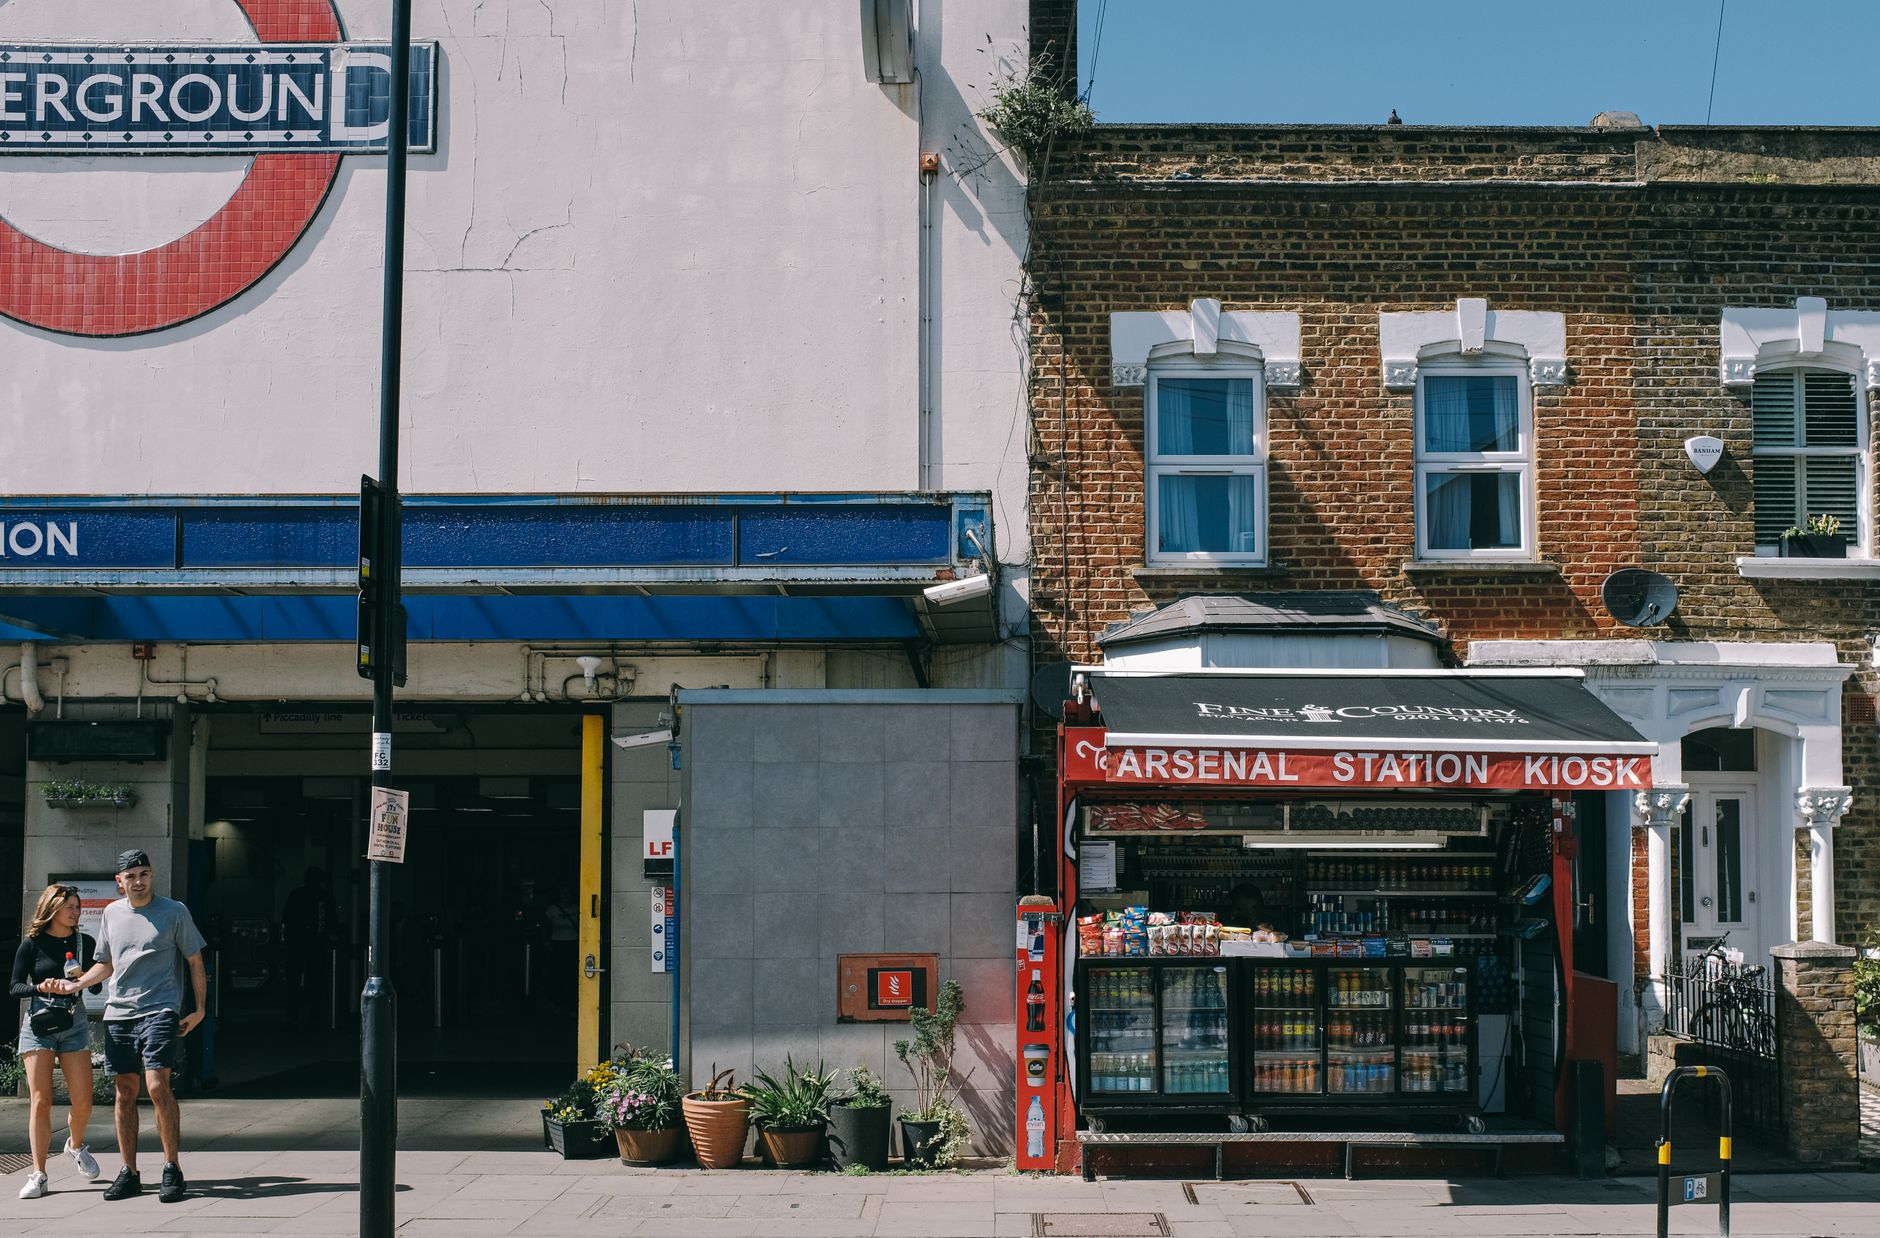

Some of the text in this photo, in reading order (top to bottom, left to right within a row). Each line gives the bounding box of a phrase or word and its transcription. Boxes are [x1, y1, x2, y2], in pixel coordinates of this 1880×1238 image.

[0, 52, 392, 142] ERGROUND
[1193, 702, 1294, 716] FINE
[1336, 705, 1516, 718] COUNTRY
[273, 712, 343, 724] Piccadilly line
[1116, 749, 1642, 786] ARSENAL STATION KIOSK
[381, 813, 399, 825] FUN
[377, 823, 401, 835] HOUSE
[649, 841, 672, 856] LF
[1686, 1180, 1693, 1198] P
